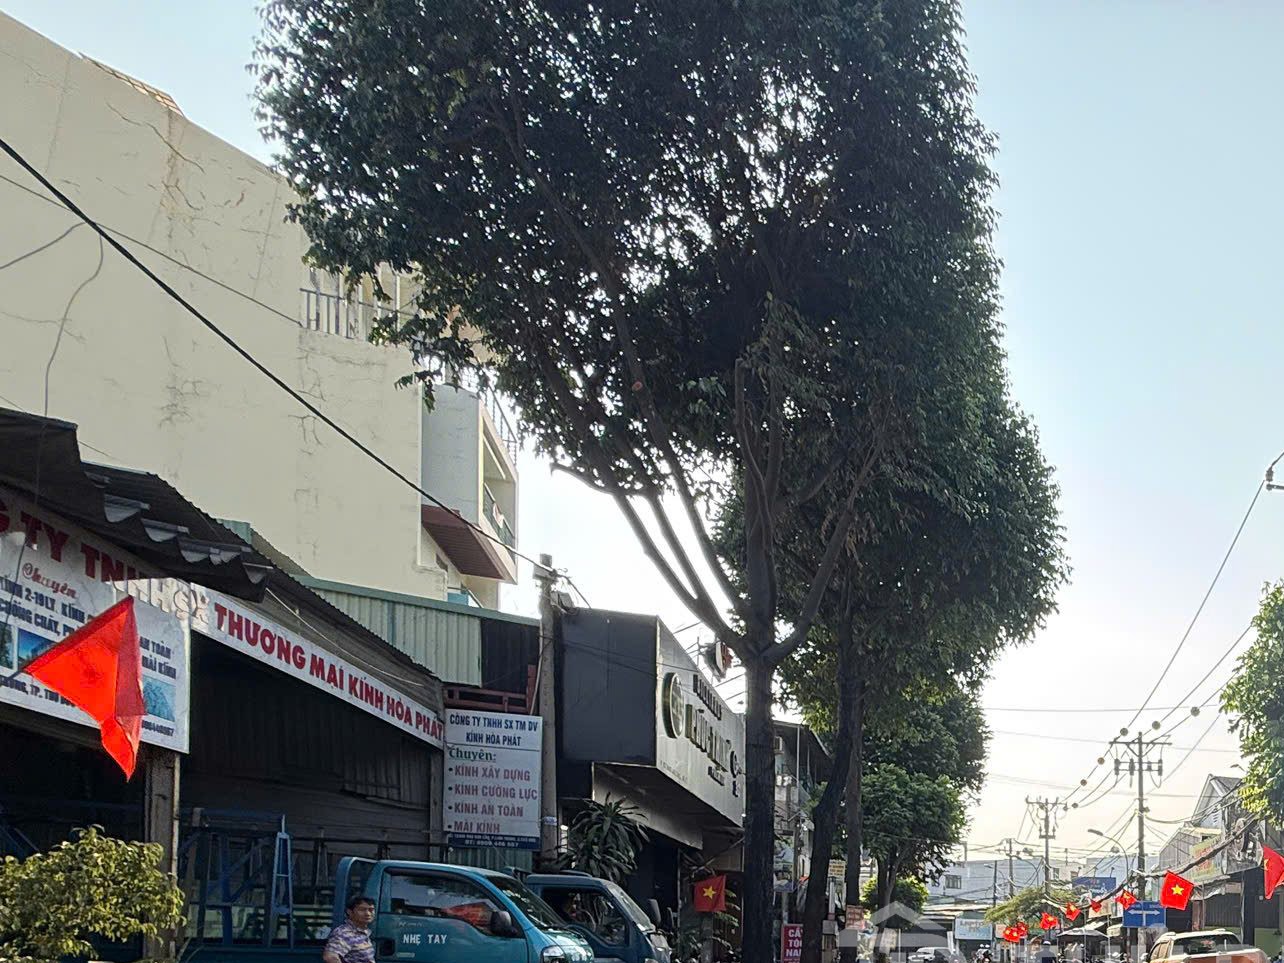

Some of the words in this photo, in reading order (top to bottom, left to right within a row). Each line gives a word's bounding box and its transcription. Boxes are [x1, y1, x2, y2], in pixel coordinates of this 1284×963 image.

[214, 602, 307, 670] THƯƠNG
[348, 673, 384, 712] KÍNH
[386, 693, 413, 727] HÒA
[449, 711, 470, 726] CÔNG
[472, 715, 482, 728] TY
[483, 717, 503, 729] TNHH
[504, 719, 514, 730] SX
[515, 720, 526, 731] TM
[481, 804, 495, 816] AN
[402, 934, 421, 946] NHẸ
[427, 934, 447, 944] TAY
